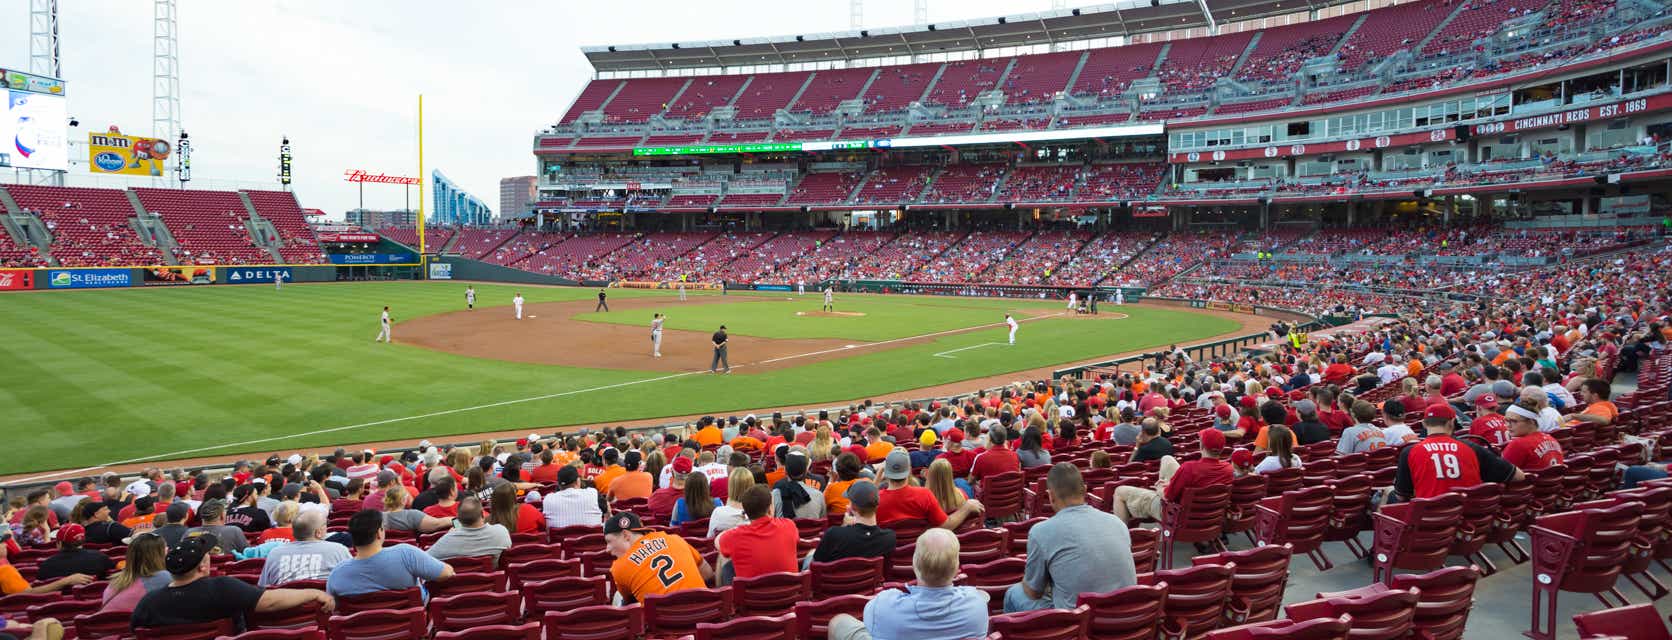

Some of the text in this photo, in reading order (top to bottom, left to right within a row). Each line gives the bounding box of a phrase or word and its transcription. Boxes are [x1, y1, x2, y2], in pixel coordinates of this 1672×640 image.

[1514, 113, 1563, 130] CINCINNATI
[1566, 109, 1590, 123] REDS
[1599, 103, 1622, 118] EST.
[1625, 98, 1647, 113] 1869
[85, 273, 128, 282] Elizabeth
[245, 270, 290, 279] DELTA
[1423, 442, 1458, 452] VOTTO
[1431, 453, 1461, 479] 19
[628, 537, 668, 566] HARDY
[280, 554, 322, 573] BEER
[650, 553, 685, 588] 2
